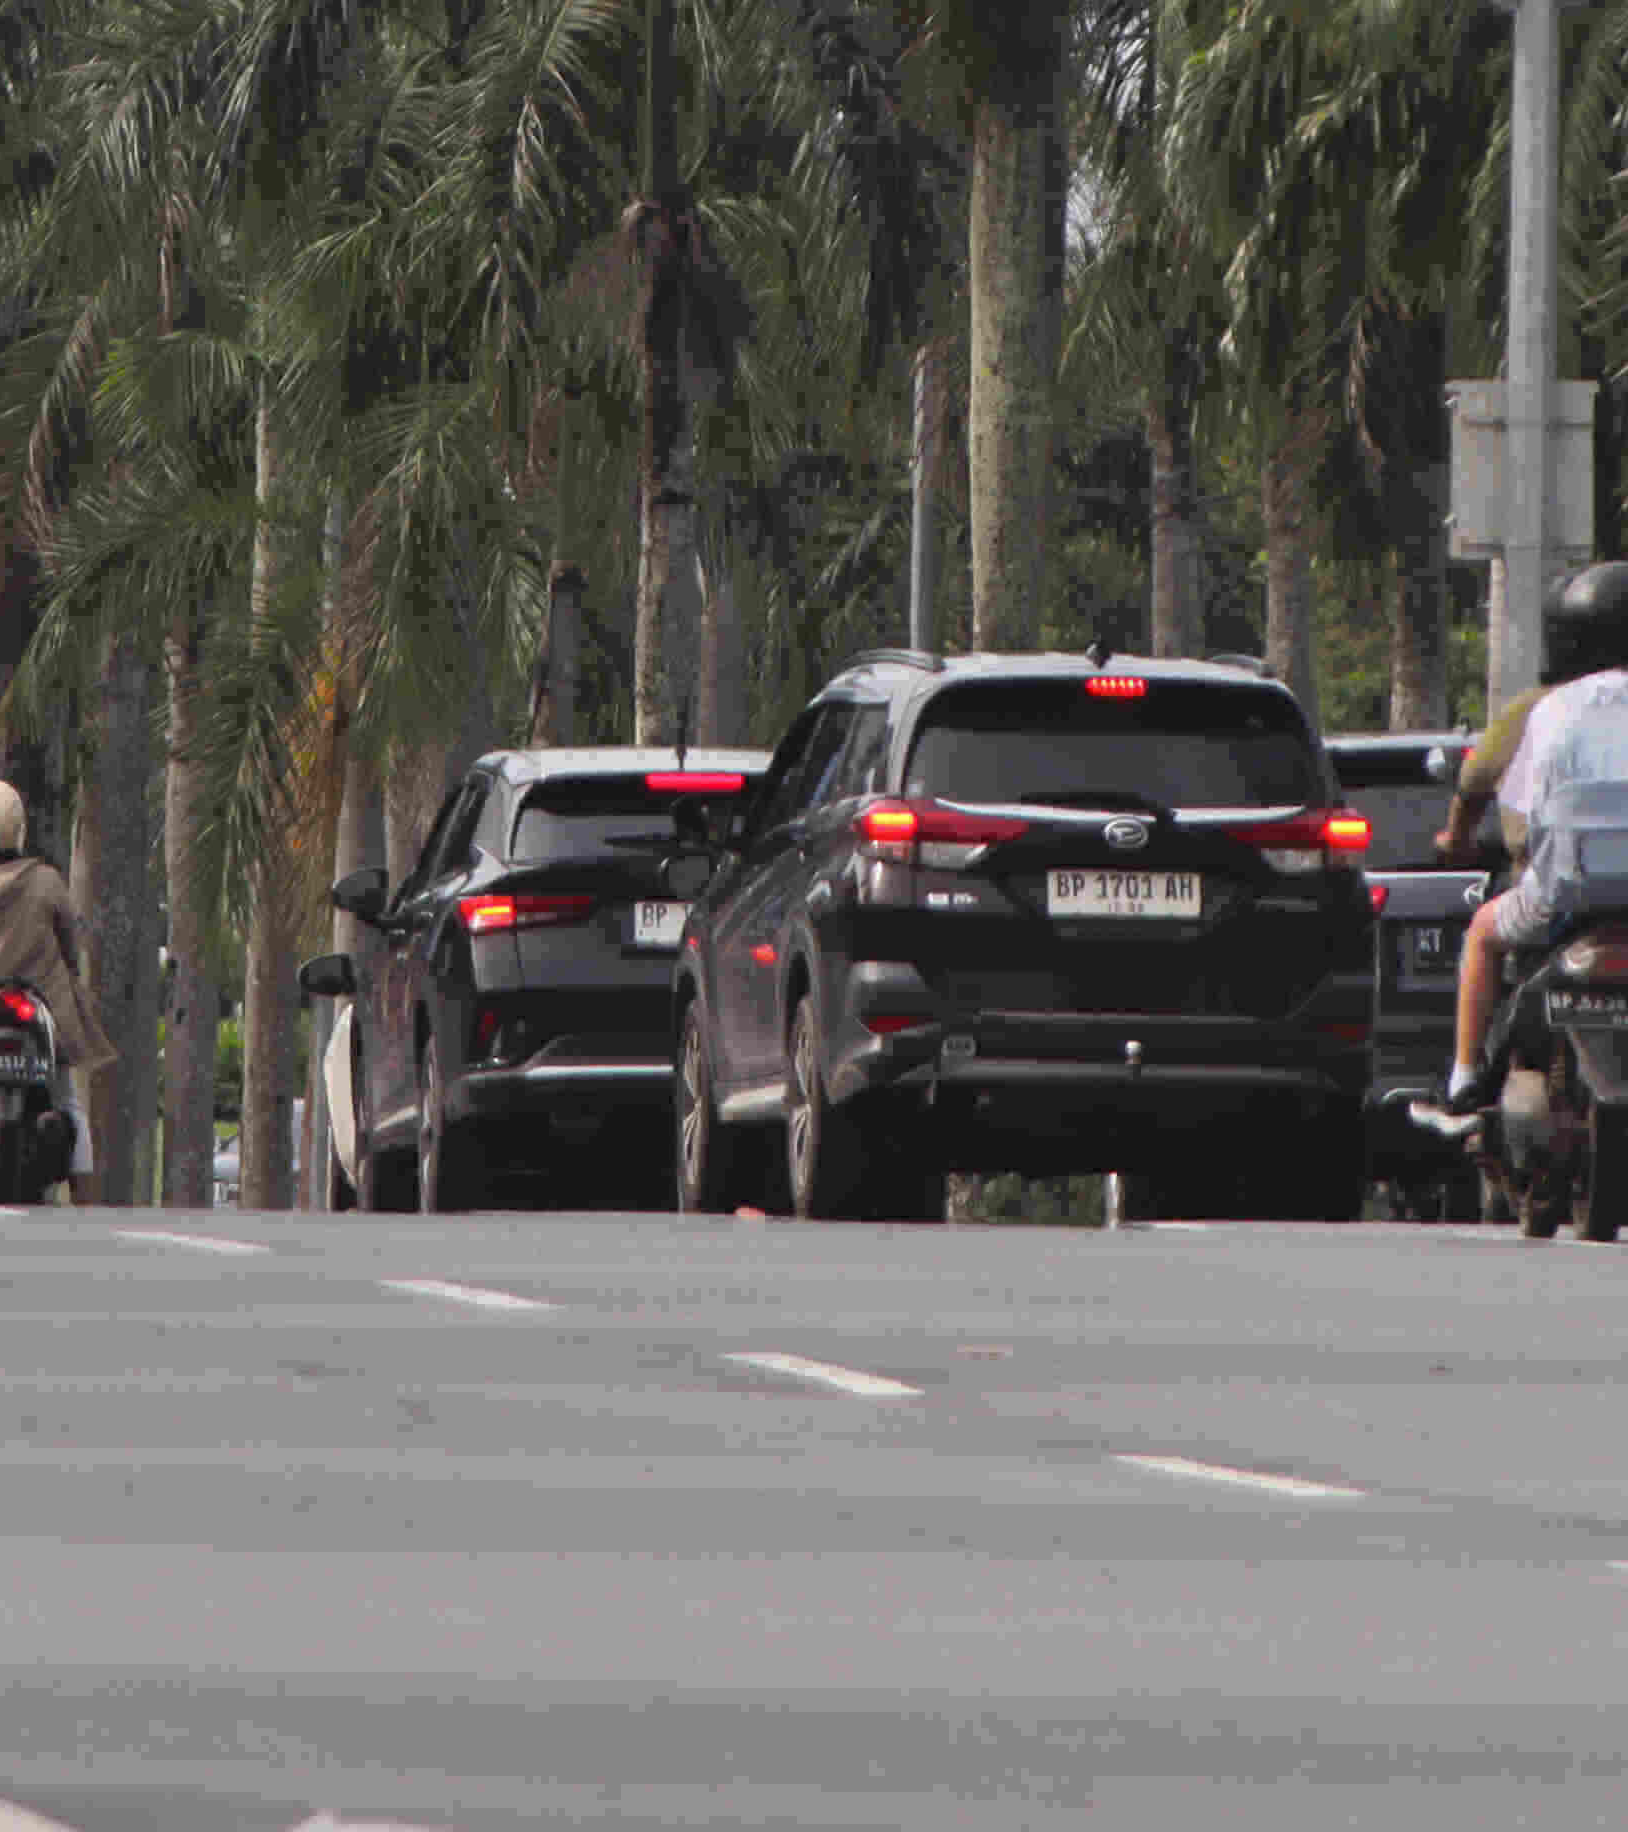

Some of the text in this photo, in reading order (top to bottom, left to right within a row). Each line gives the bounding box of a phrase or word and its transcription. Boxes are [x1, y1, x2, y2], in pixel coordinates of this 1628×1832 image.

[1057, 872, 1194, 900] BP 1701 AH
[643, 902, 668, 928] BP
[1550, 991, 1573, 1009] BP
